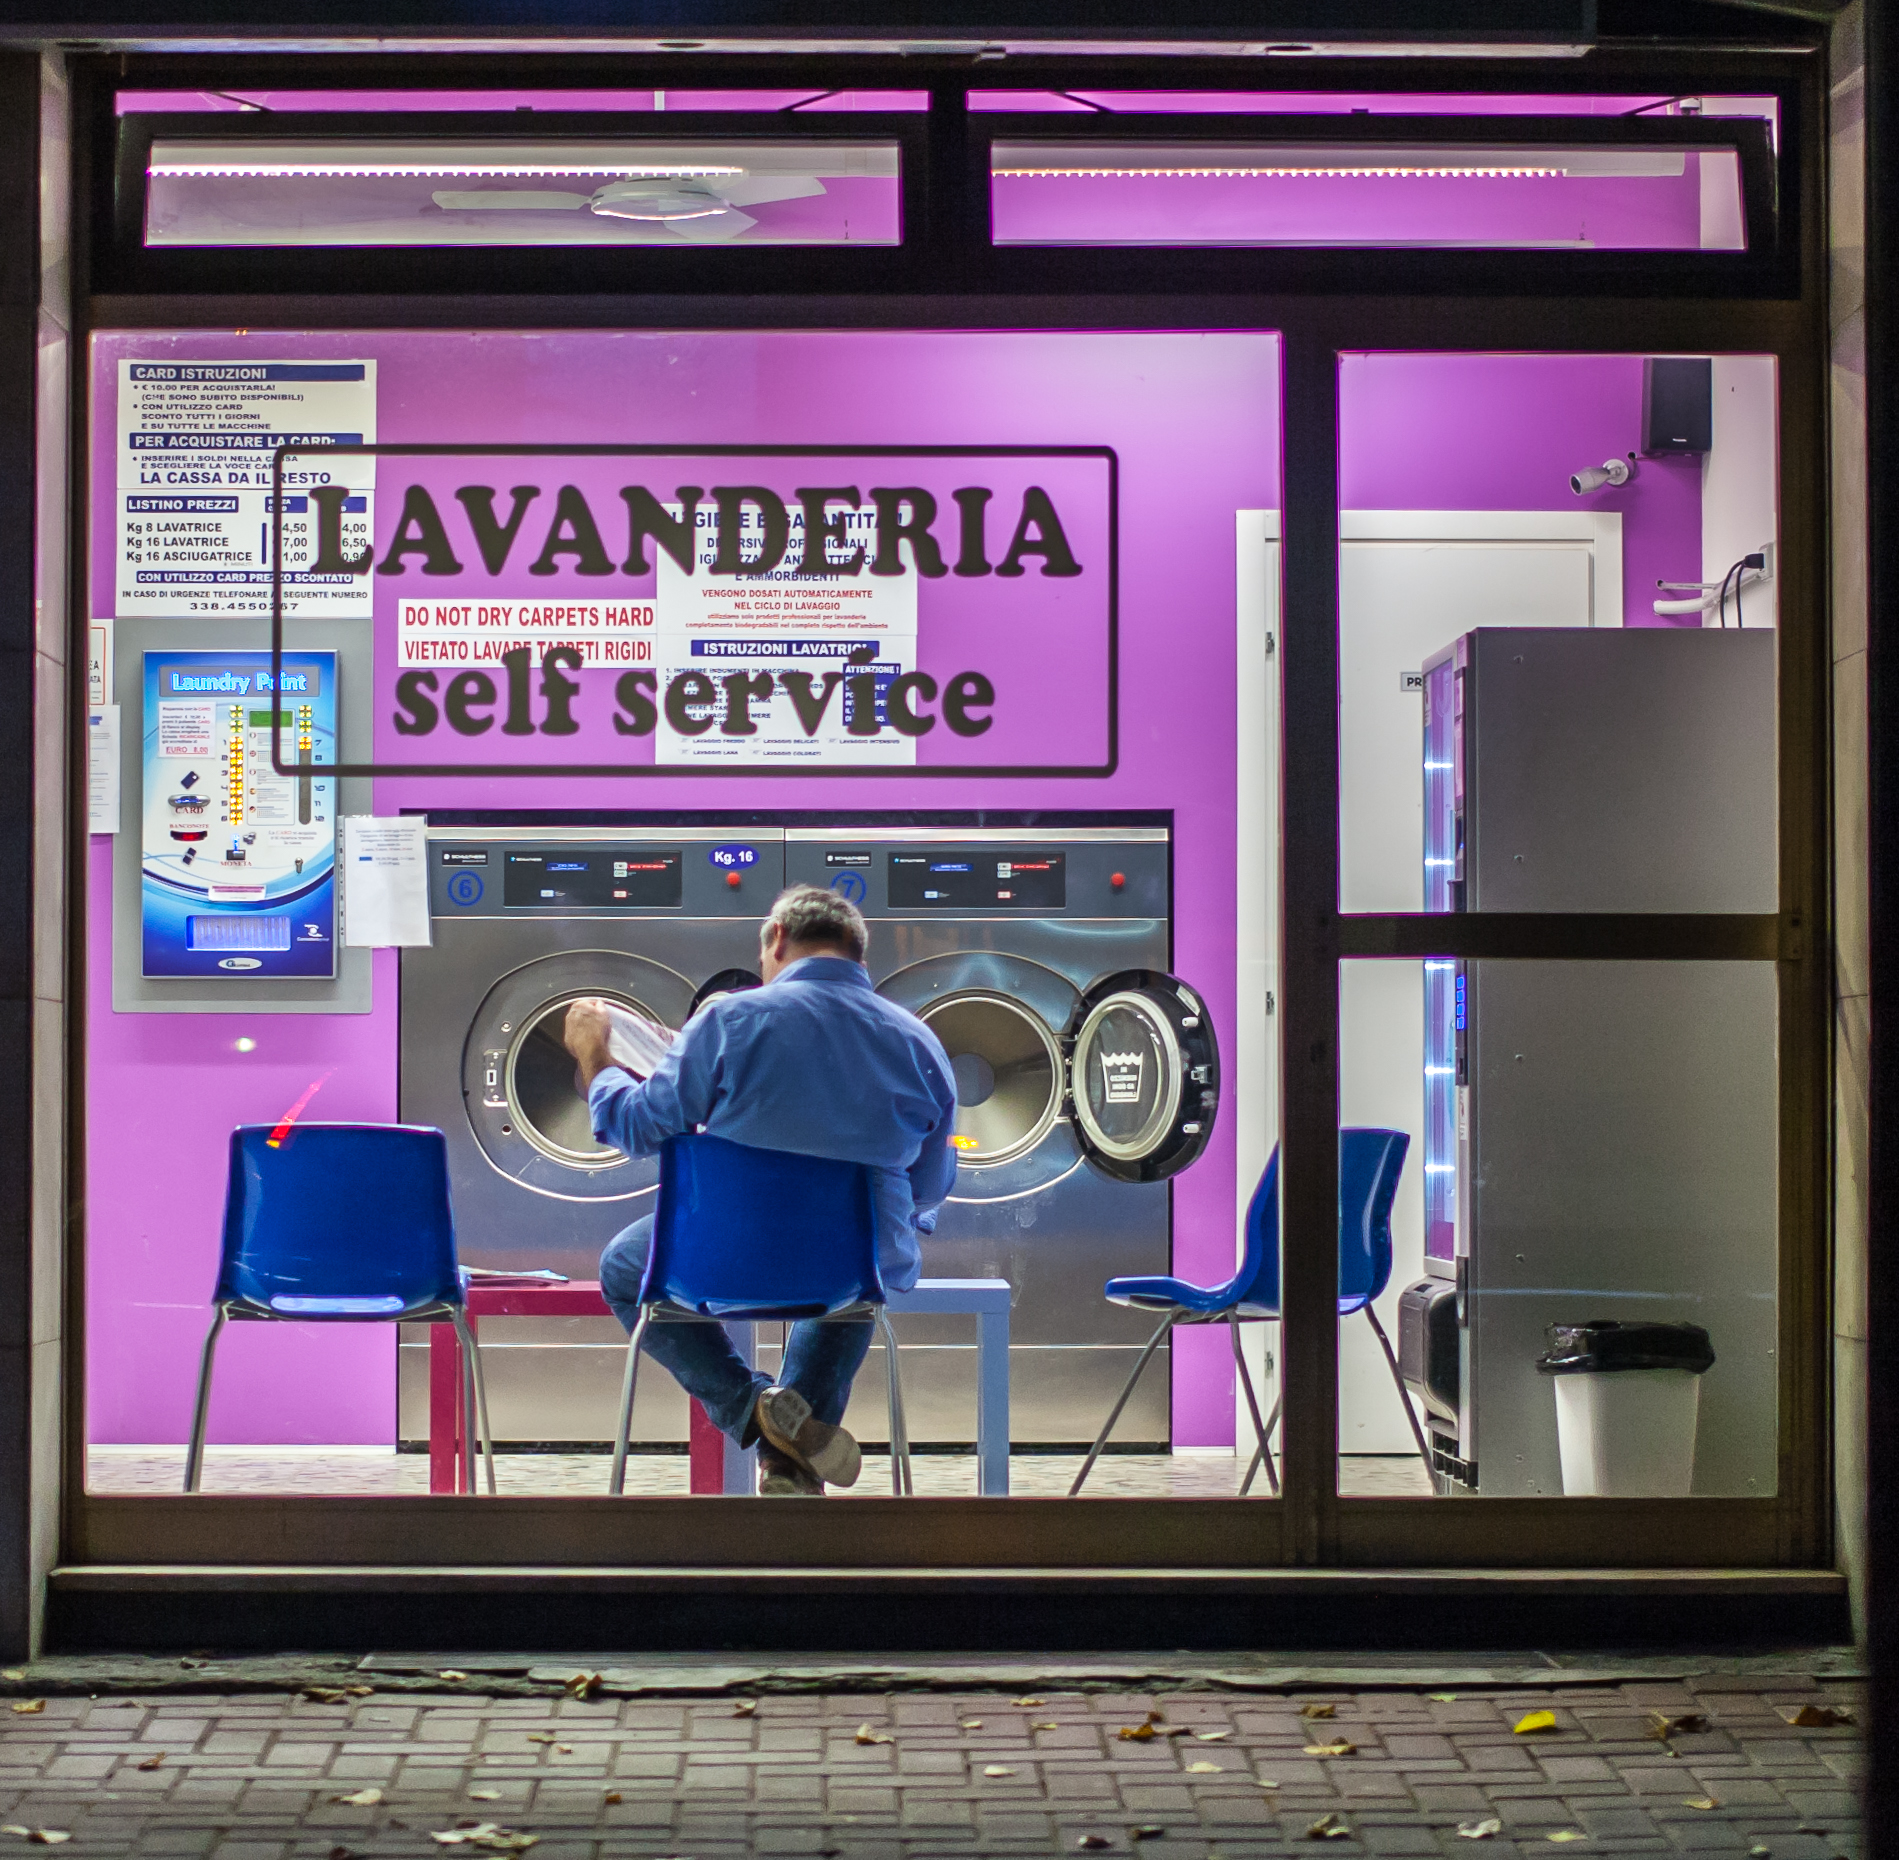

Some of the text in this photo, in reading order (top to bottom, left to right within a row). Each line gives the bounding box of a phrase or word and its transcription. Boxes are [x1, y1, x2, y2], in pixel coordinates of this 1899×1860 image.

[136, 368, 266, 379] CARD ISTRUZIONI
[135, 436, 164, 447] PER
[168, 436, 263, 447] ACQUISTARE
[268, 436, 286, 447] LA
[140, 472, 331, 484] LA CASSA DA IL RESTO
[128, 500, 236, 510] LISTINO PREZZI
[127, 523, 142, 534] Kg
[146, 523, 152, 532] 8
[157, 523, 222, 532] LAVATRICE
[308, 486, 1082, 576] LAVANDERIA
[127, 538, 142, 549] Kg
[147, 538, 160, 547] 16
[164, 538, 229, 547] LAVATRICE
[283, 538, 307, 548] 7,00
[127, 552, 142, 563] Kg
[147, 552, 160, 561] 16
[164, 552, 252, 561] ASCIUGATRICE
[138, 573, 162, 582] CON
[164, 573, 213, 582] UTILIZZO
[217, 573, 246, 582] CARD
[295, 573, 352, 582] SCONTATO
[406, 607, 654, 626] DO NOT DRY CARPETS HARD
[405, 641, 468, 660] VIETATO
[605, 641, 651, 660] RIGIDI
[704, 644, 788, 655] ISTRUZIONI
[172, 671, 251, 694] Laundry
[394, 648, 996, 738] self service
[714, 851, 753, 865] Kg. 16
[458, 879, 472, 898] 6
[842, 880, 855, 898] 7
